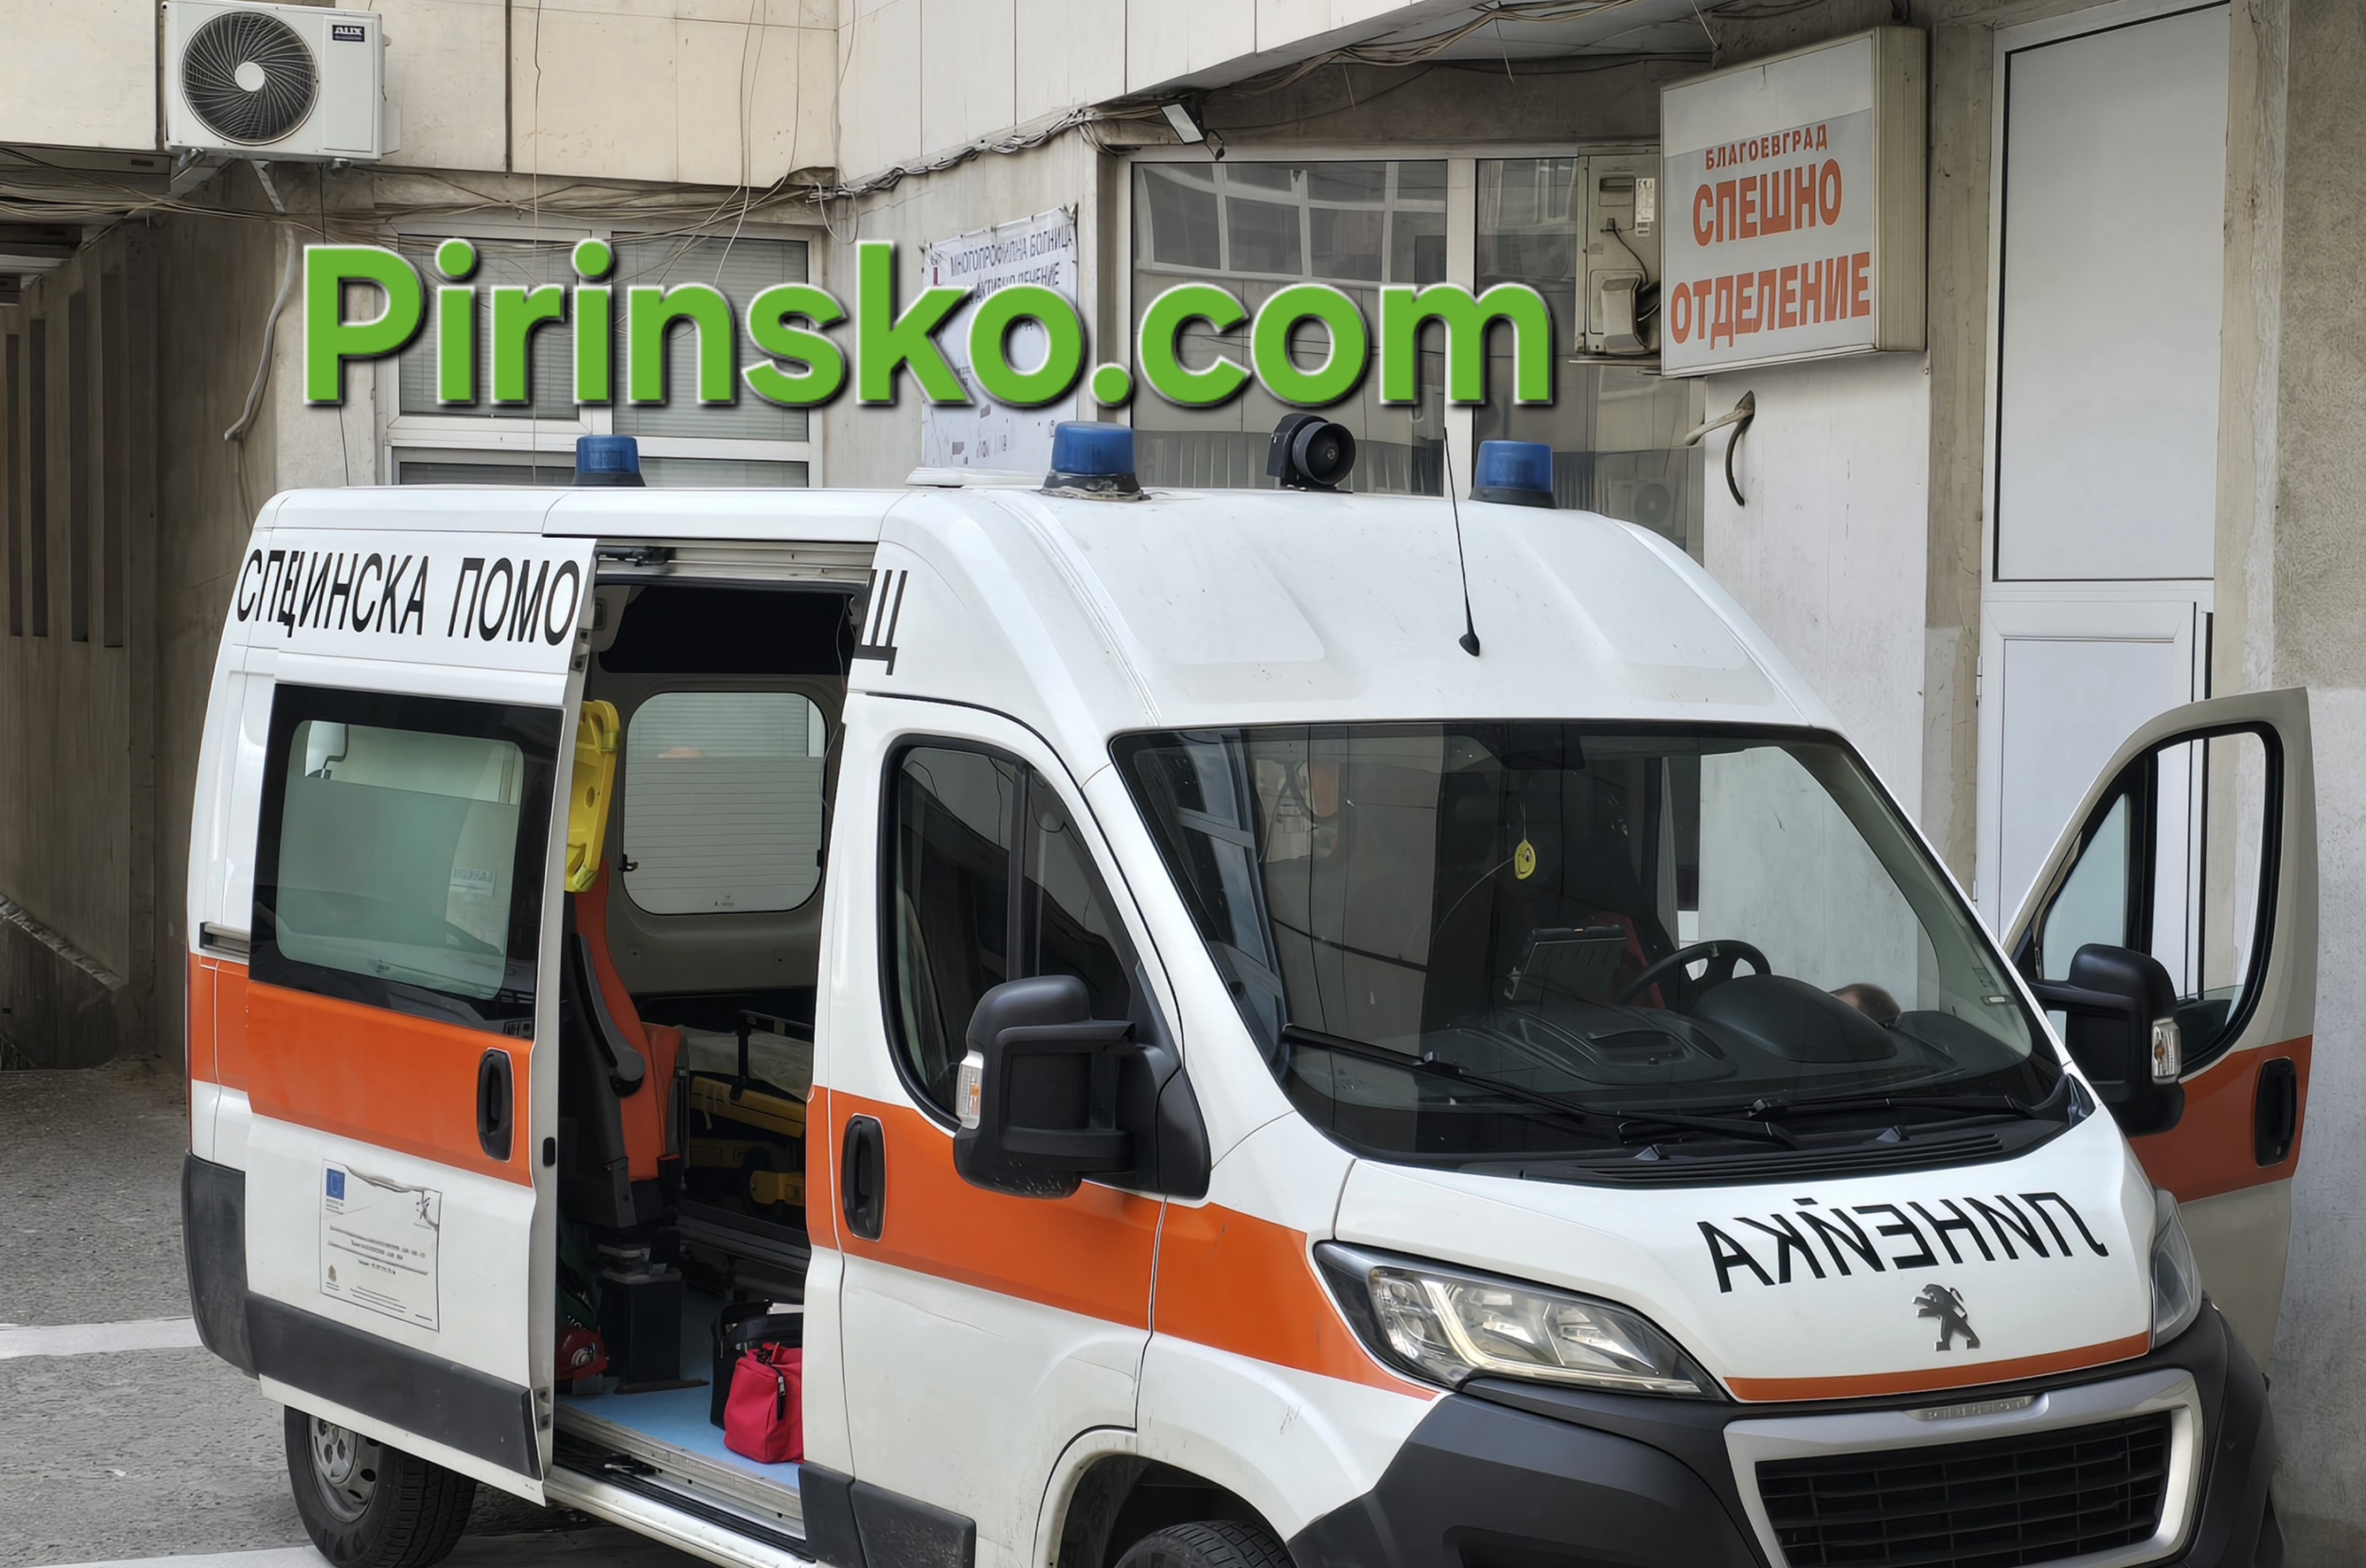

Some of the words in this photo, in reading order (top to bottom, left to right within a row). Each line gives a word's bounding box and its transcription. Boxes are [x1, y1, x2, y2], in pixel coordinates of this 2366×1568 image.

[334, 27, 363, 35] AUX
[1705, 124, 1828, 170] БЛАГОЕВГРАД
[1693, 158, 1842, 247] СПЕШНО
[1670, 251, 1871, 350] ОТДЕЛЕНИЕ
